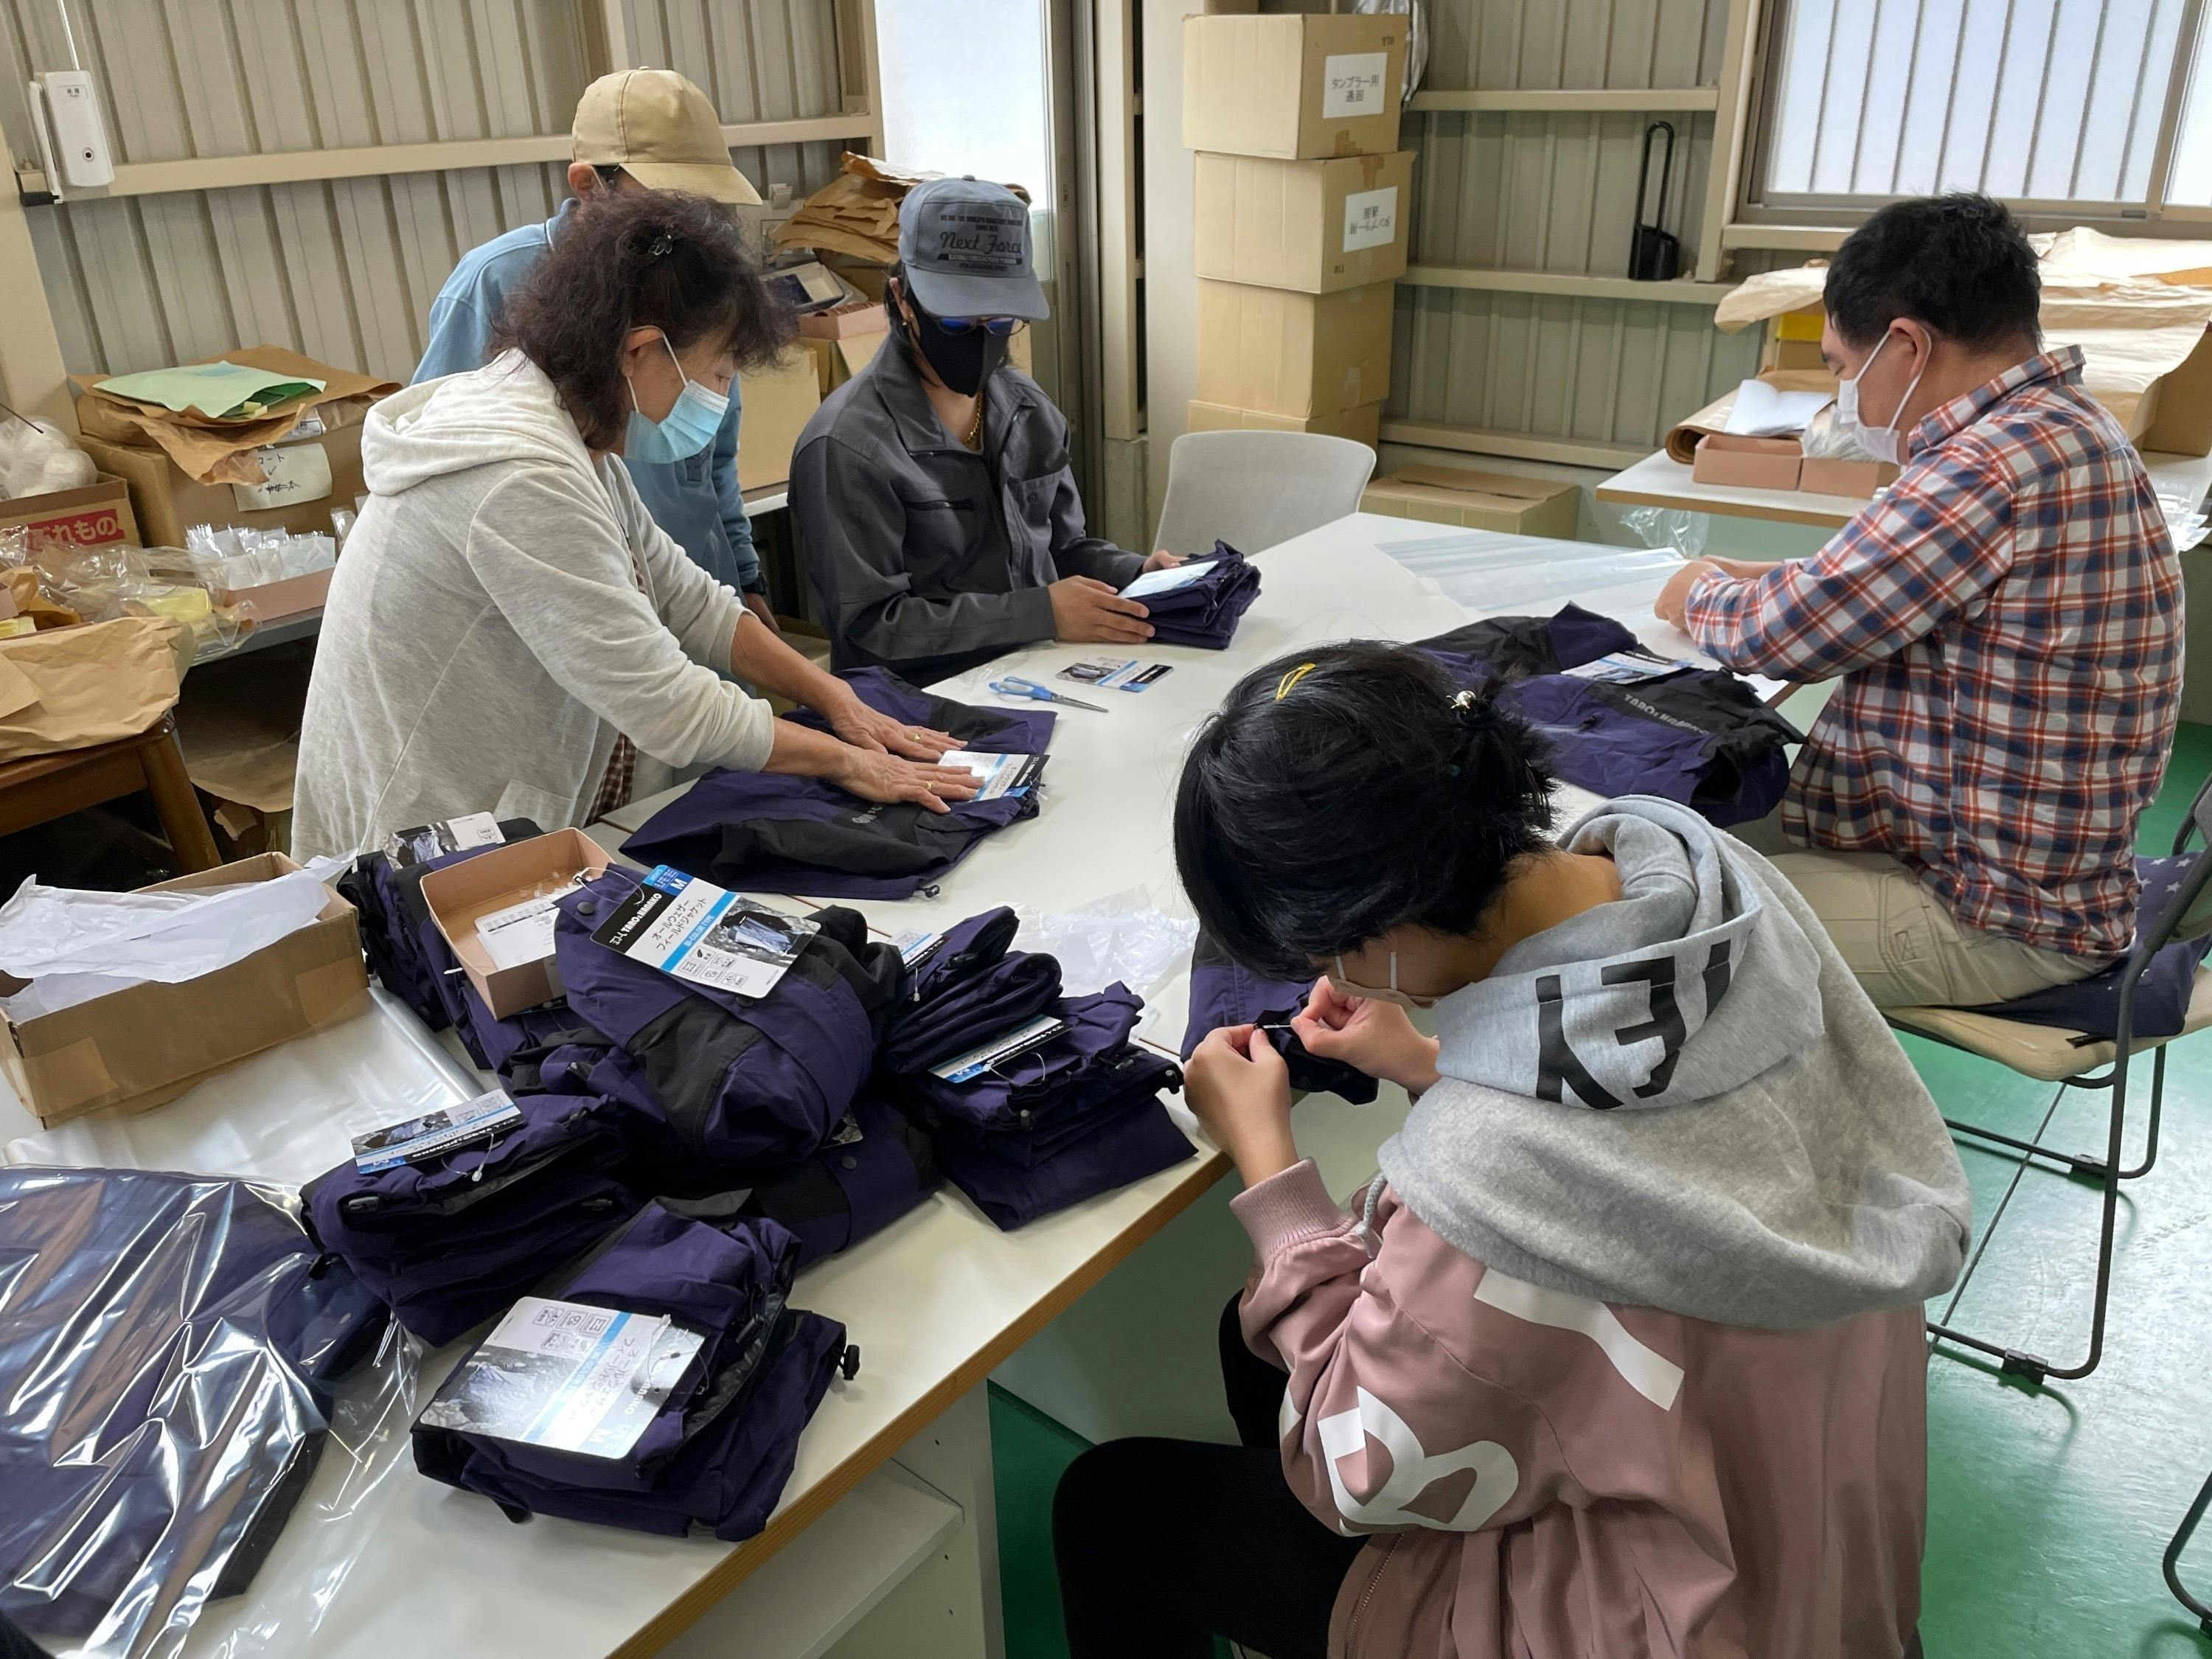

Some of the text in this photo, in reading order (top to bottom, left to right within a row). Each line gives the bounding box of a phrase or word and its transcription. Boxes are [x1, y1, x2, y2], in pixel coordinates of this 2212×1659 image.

[1332, 74, 1380, 89] タンブラー用
[939, 231, 1022, 254] Next Force
[670, 877, 688, 891] M
[653, 900, 691, 941] オールウェザー
[656, 898, 708, 950] フィールドジャケット
